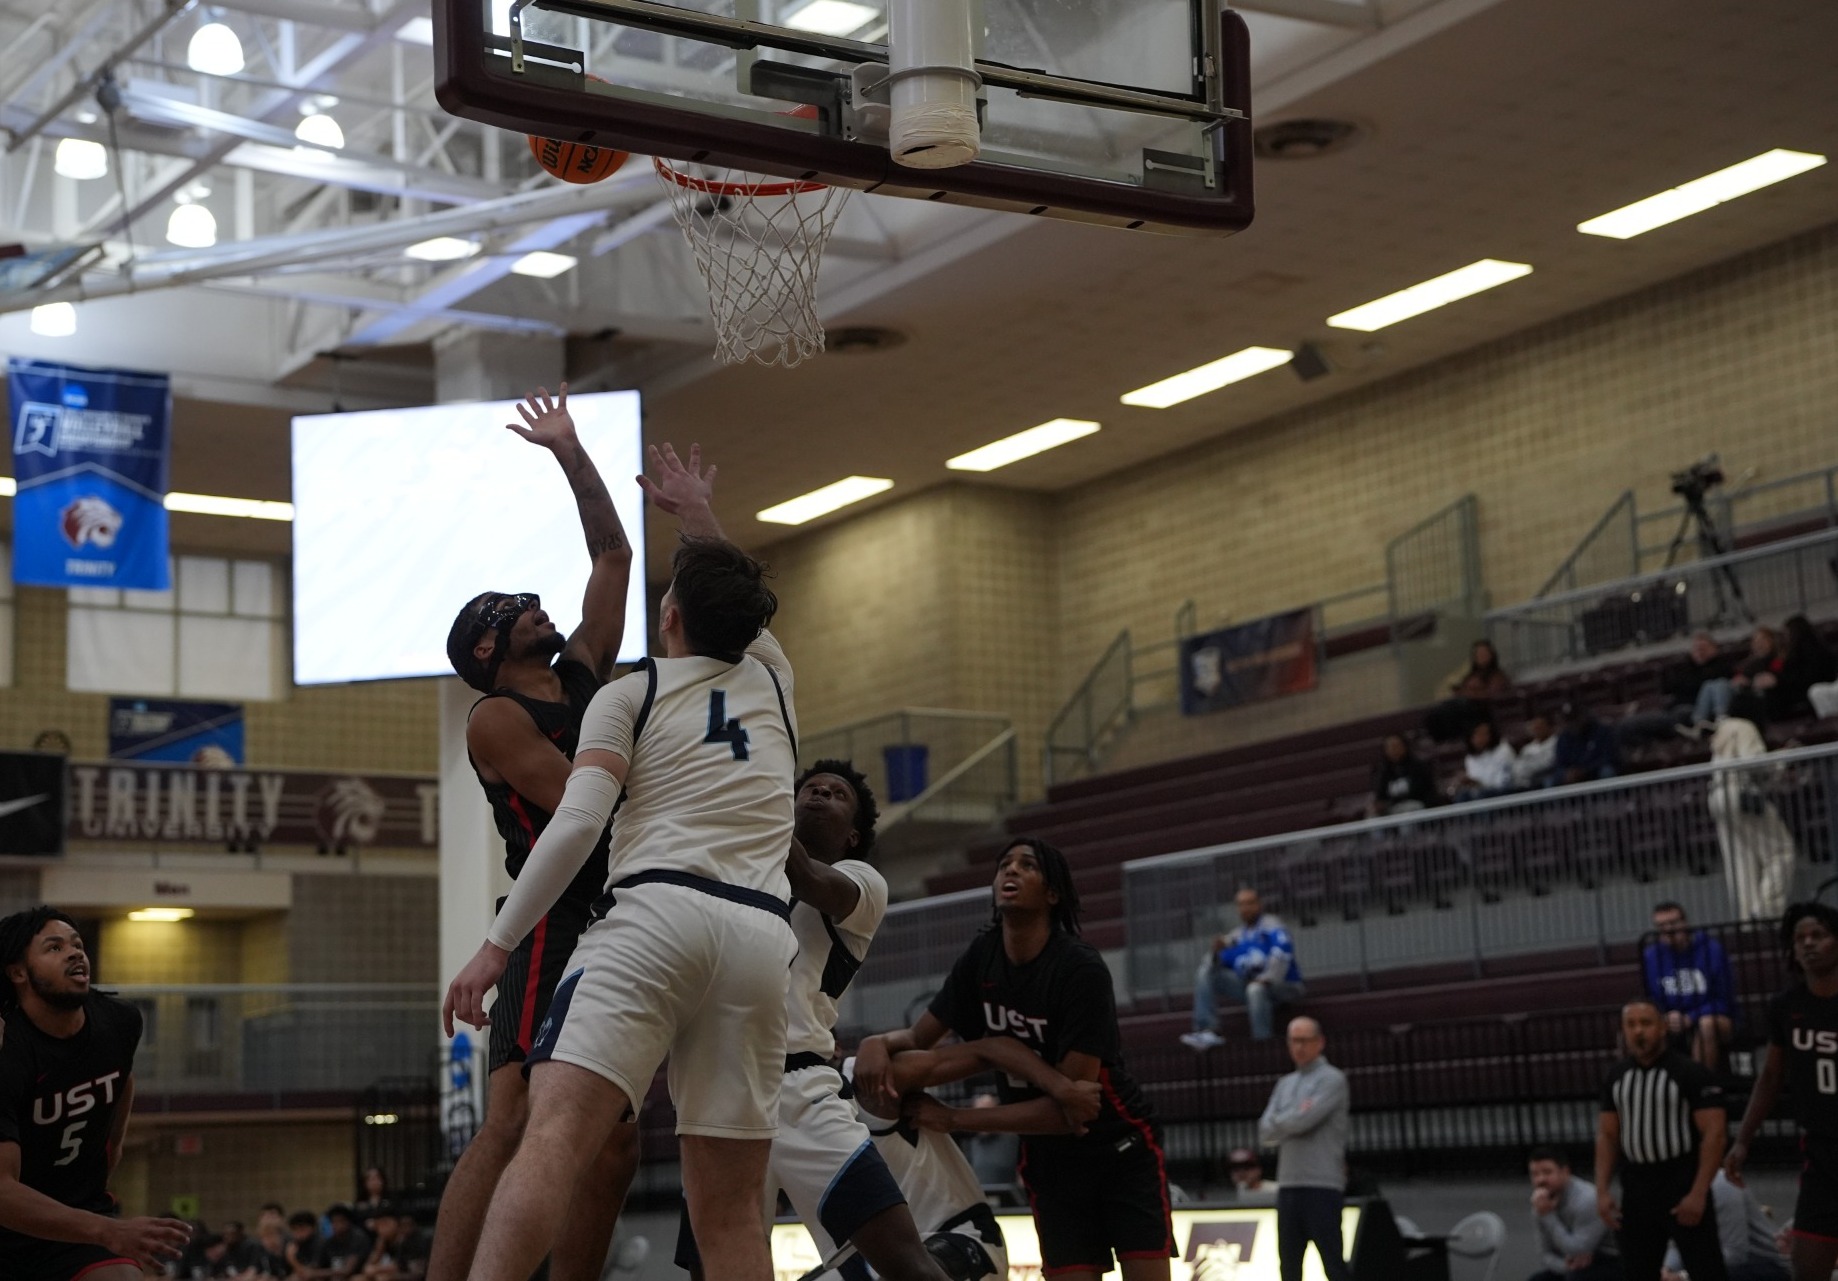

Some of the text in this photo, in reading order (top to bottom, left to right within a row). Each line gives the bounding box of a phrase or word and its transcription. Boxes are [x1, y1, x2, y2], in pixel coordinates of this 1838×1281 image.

[702, 688, 751, 761] 4
[74, 768, 286, 833] TRINITY
[82, 818, 273, 840] UNIVERSITY
[983, 1001, 1048, 1044] UST
[1792, 1027, 1838, 1054] US
[33, 1070, 121, 1126] UST
[1816, 1058, 1838, 1095] 0
[53, 1120, 88, 1167] 5
